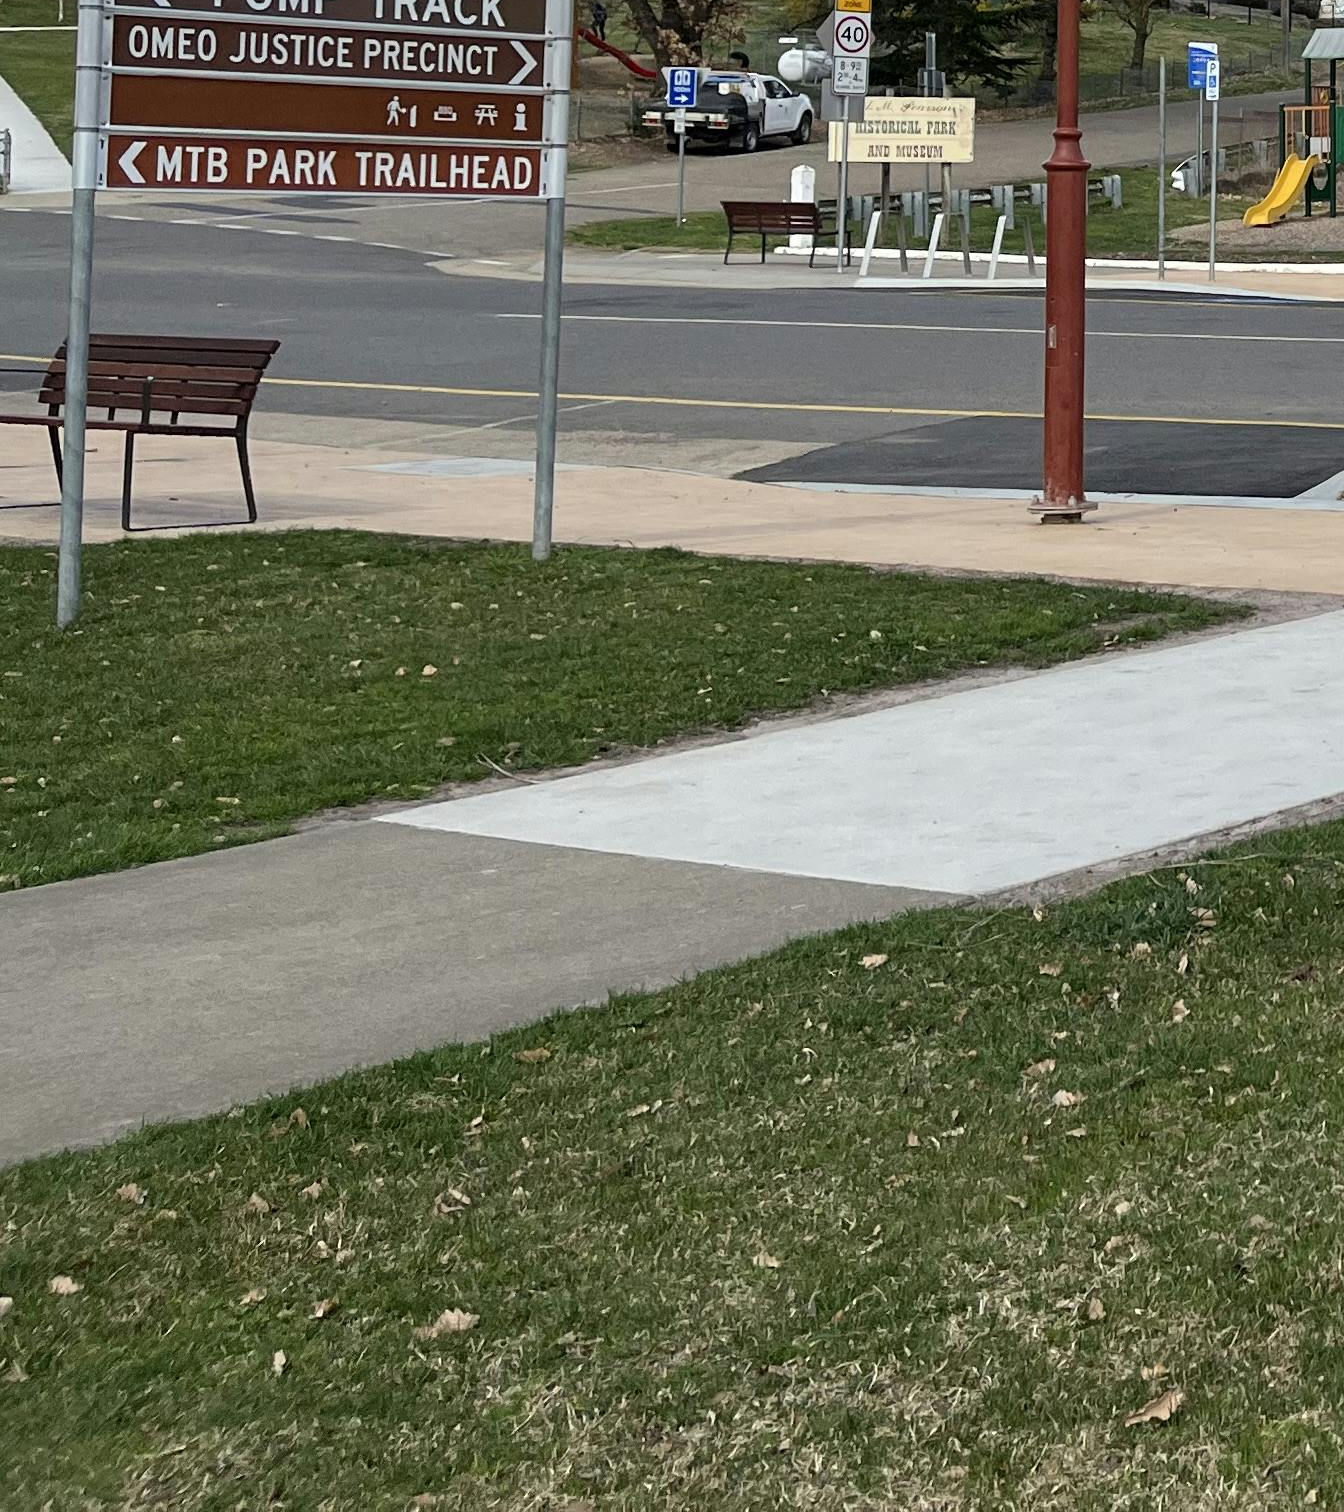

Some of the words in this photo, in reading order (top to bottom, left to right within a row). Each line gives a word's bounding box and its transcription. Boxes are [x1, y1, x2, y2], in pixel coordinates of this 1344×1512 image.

[841, 26, 864, 43] 40
[128, 24, 217, 62] OMEO
[229, 31, 354, 68] JUSTICE
[363, 38, 499, 76] PRECINCT
[1210, 62, 1217, 74] P
[855, 119, 921, 135] HISTORICAL
[926, 121, 957, 135] PARK
[867, 144, 890, 158] AND
[895, 145, 944, 159] MUSEUM
[156, 145, 229, 184] MTB
[246, 147, 337, 186] PARK
[355, 151, 534, 190] TRAILHEAD
